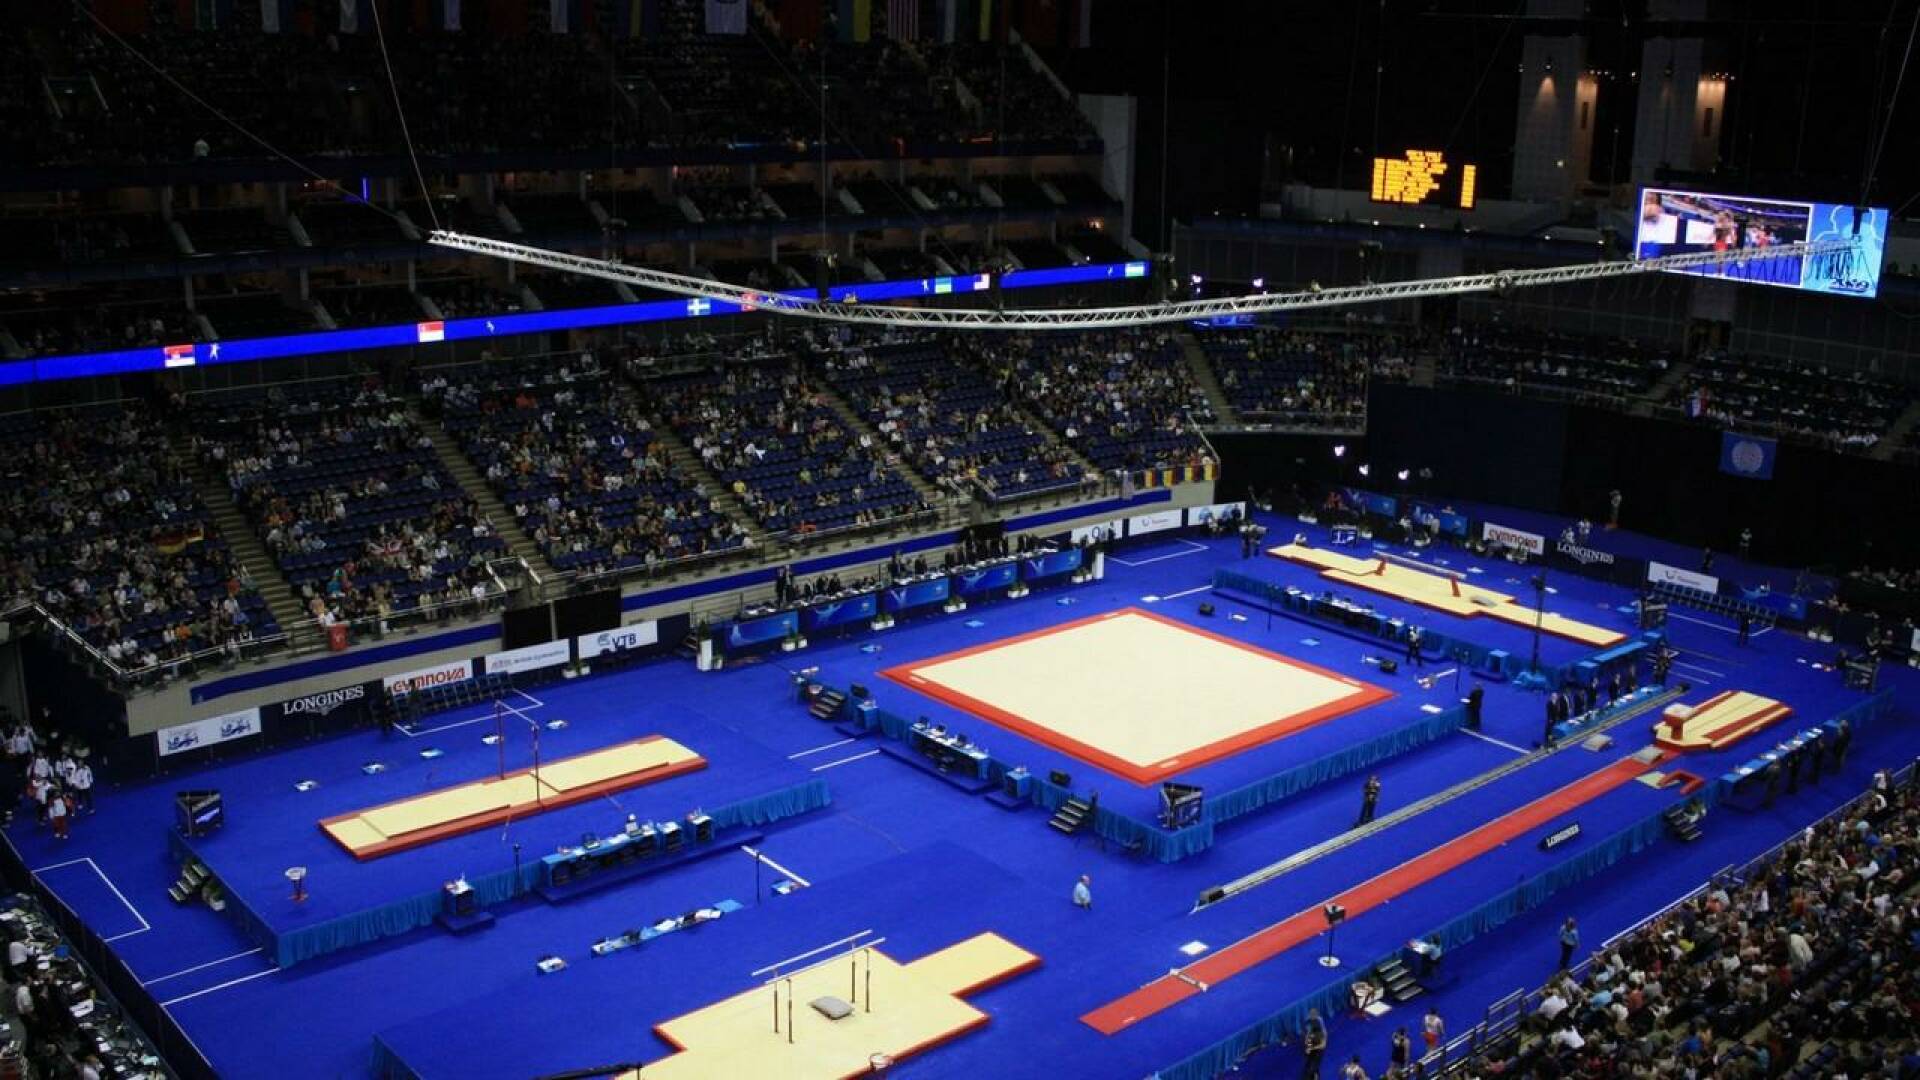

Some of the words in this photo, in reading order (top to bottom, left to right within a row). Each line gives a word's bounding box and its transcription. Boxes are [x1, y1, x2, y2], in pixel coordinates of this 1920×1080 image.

[1557, 541, 1614, 564] LONGINES
[612, 633, 636, 649] VTB
[283, 685, 364, 715] LONGINES
